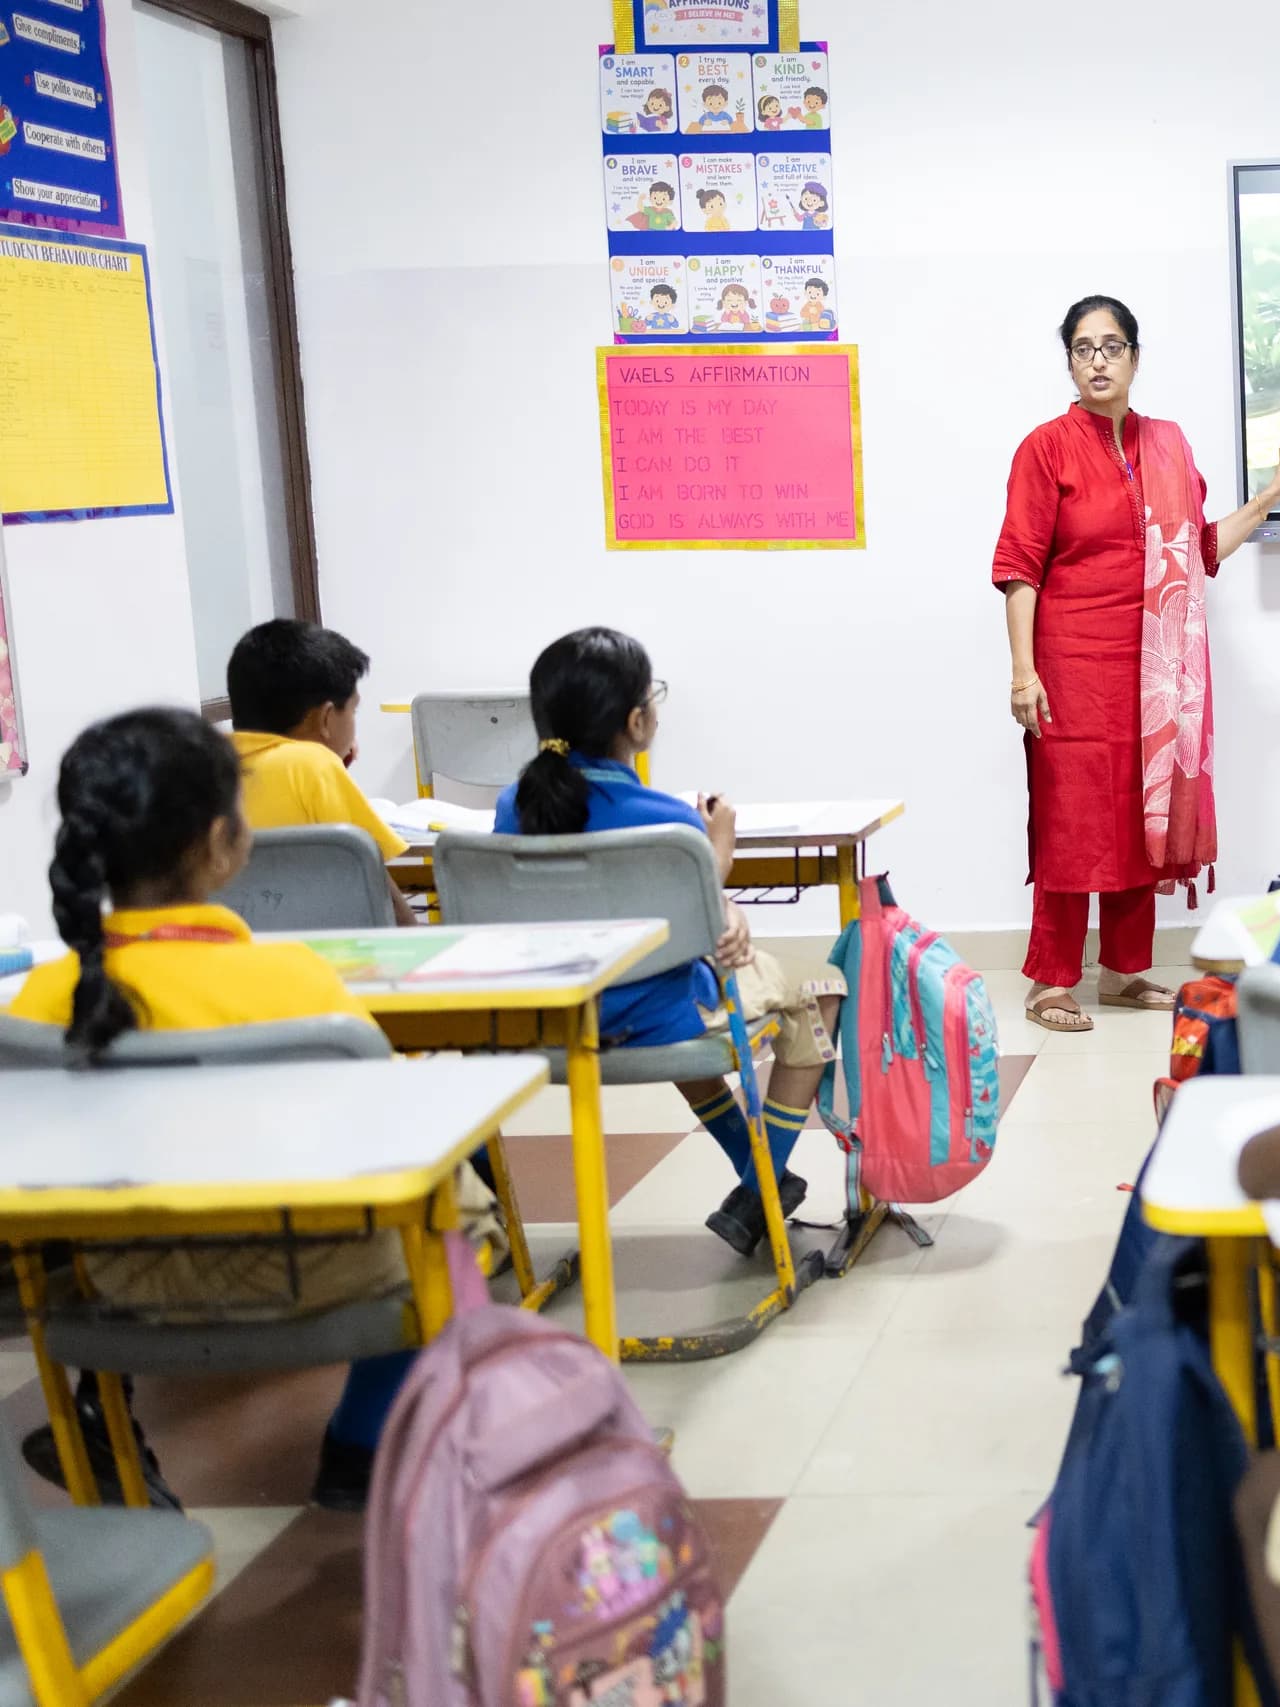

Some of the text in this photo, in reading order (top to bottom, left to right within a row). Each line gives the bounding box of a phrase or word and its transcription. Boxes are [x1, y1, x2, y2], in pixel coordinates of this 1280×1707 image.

[688, 10, 713, 18] BELIEVE
[15, 17, 80, 49] Give compliments.
[704, 56, 714, 64] try
[616, 67, 654, 77] SMART
[698, 64, 728, 76] BEST
[774, 64, 805, 74] KIND
[36, 74, 50, 90] Use
[51, 78, 71, 96] polite
[26, 125, 64, 146] Cooperate
[65, 132, 81, 148] with
[622, 165, 657, 175] BRAVE
[696, 164, 742, 173] MISTAKES
[773, 164, 817, 173] CREATIVE
[14, 180, 100, 208] Show your appreciation.
[0, 240, 128, 272] TUDENT BEHAVIOUR CHART
[629, 267, 669, 276] UNIQUE
[705, 265, 744, 276] HAPPY
[774, 266, 824, 274] THANKFUL
[620, 366, 810, 383] VAELS AFFIRMATION
[613, 400, 778, 416] TODAY IS MY DAY
[616, 427, 765, 444] I AM THE BEST
[617, 456, 740, 472] I CAN DO IT
[619, 484, 809, 501] I AM BORN TO WIN
[618, 511, 848, 529] GOD IS ALWAYS WITH ME
